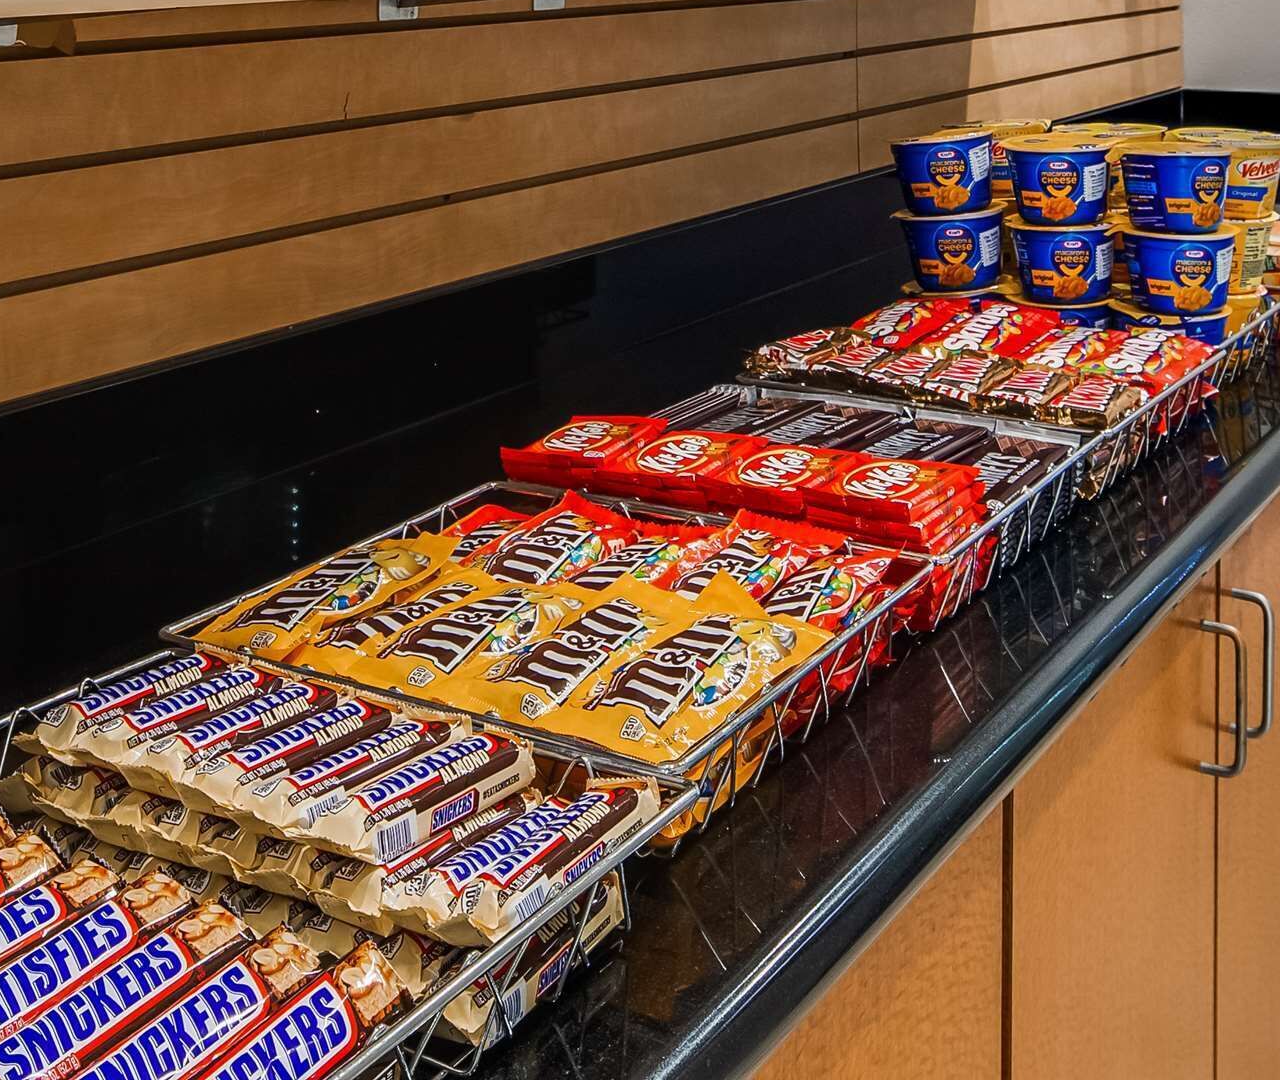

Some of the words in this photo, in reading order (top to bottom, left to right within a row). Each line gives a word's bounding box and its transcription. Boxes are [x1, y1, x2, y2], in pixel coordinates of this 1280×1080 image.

[1232, 190, 1258, 198] Original
[1034, 274, 1054, 282] original
[943, 304, 1018, 351] Skittles
[1104, 328, 1175, 373] Skittles
[1056, 376, 1118, 411] TWIX
[84, 656, 203, 711] SNICKERS
[154, 668, 202, 696] ALMOND
[410, 667, 426, 684] 250
[134, 668, 257, 726] SNICKERS
[187, 684, 311, 743] SNICKERS
[207, 683, 255, 713] ALMOND
[263, 699, 310, 729] ALMOND
[522, 694, 538, 713] 250
[241, 701, 363, 764] SNICKERS
[315, 715, 364, 747] ALMOND
[622, 716, 639, 738] 250
[295, 722, 422, 782] SNICKERS
[370, 730, 420, 762] ALMOND
[367, 735, 489, 804] SNICKERS
[442, 750, 490, 785] ALMOND
[433, 794, 474, 829] SNICKERS
[482, 773, 521, 801] #EATASNICKERS
[561, 801, 611, 843] ALMOND
